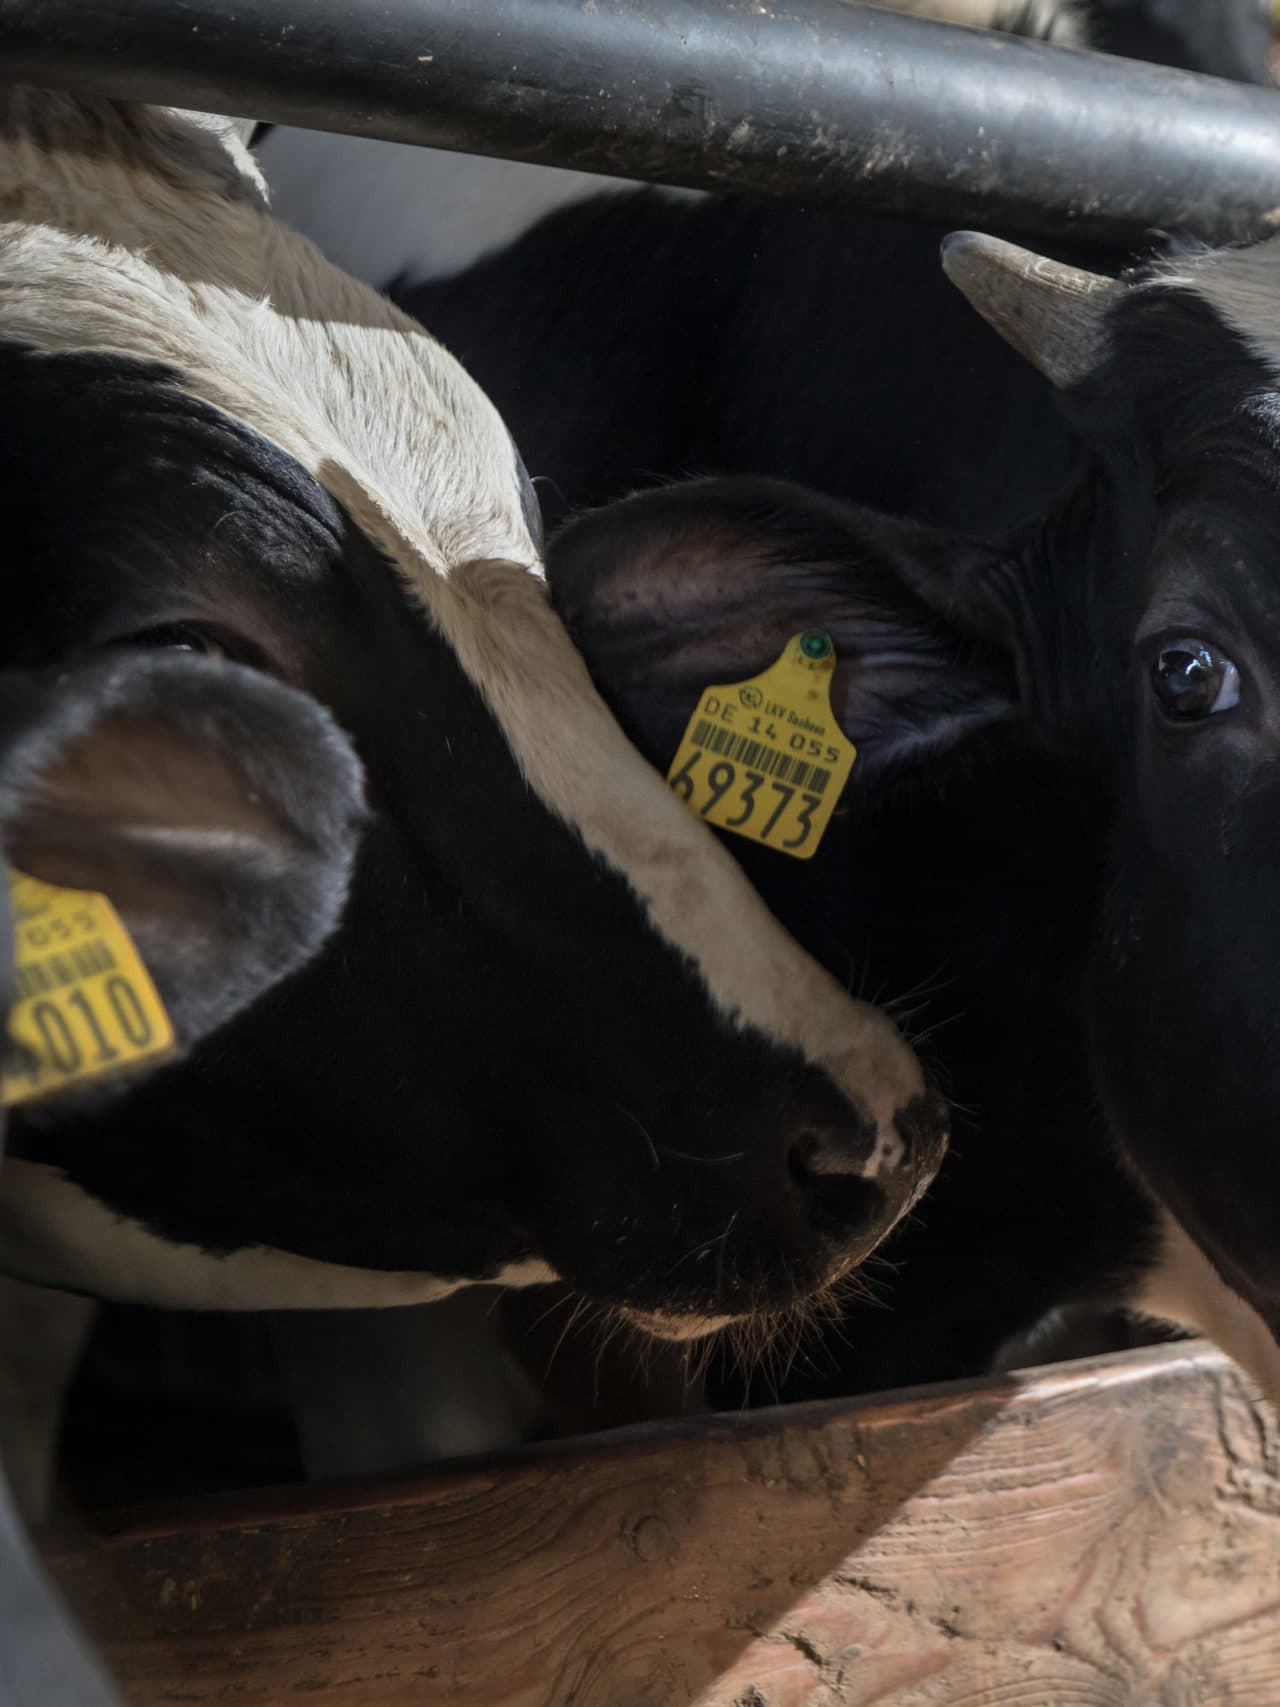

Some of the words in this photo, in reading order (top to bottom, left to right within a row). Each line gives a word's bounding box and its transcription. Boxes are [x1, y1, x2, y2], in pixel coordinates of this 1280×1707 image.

[704, 696, 737, 722] DE
[748, 716, 777, 740] 14
[789, 733, 840, 763] 055
[670, 752, 822, 849] 69373
[29, 975, 153, 1084] 010
